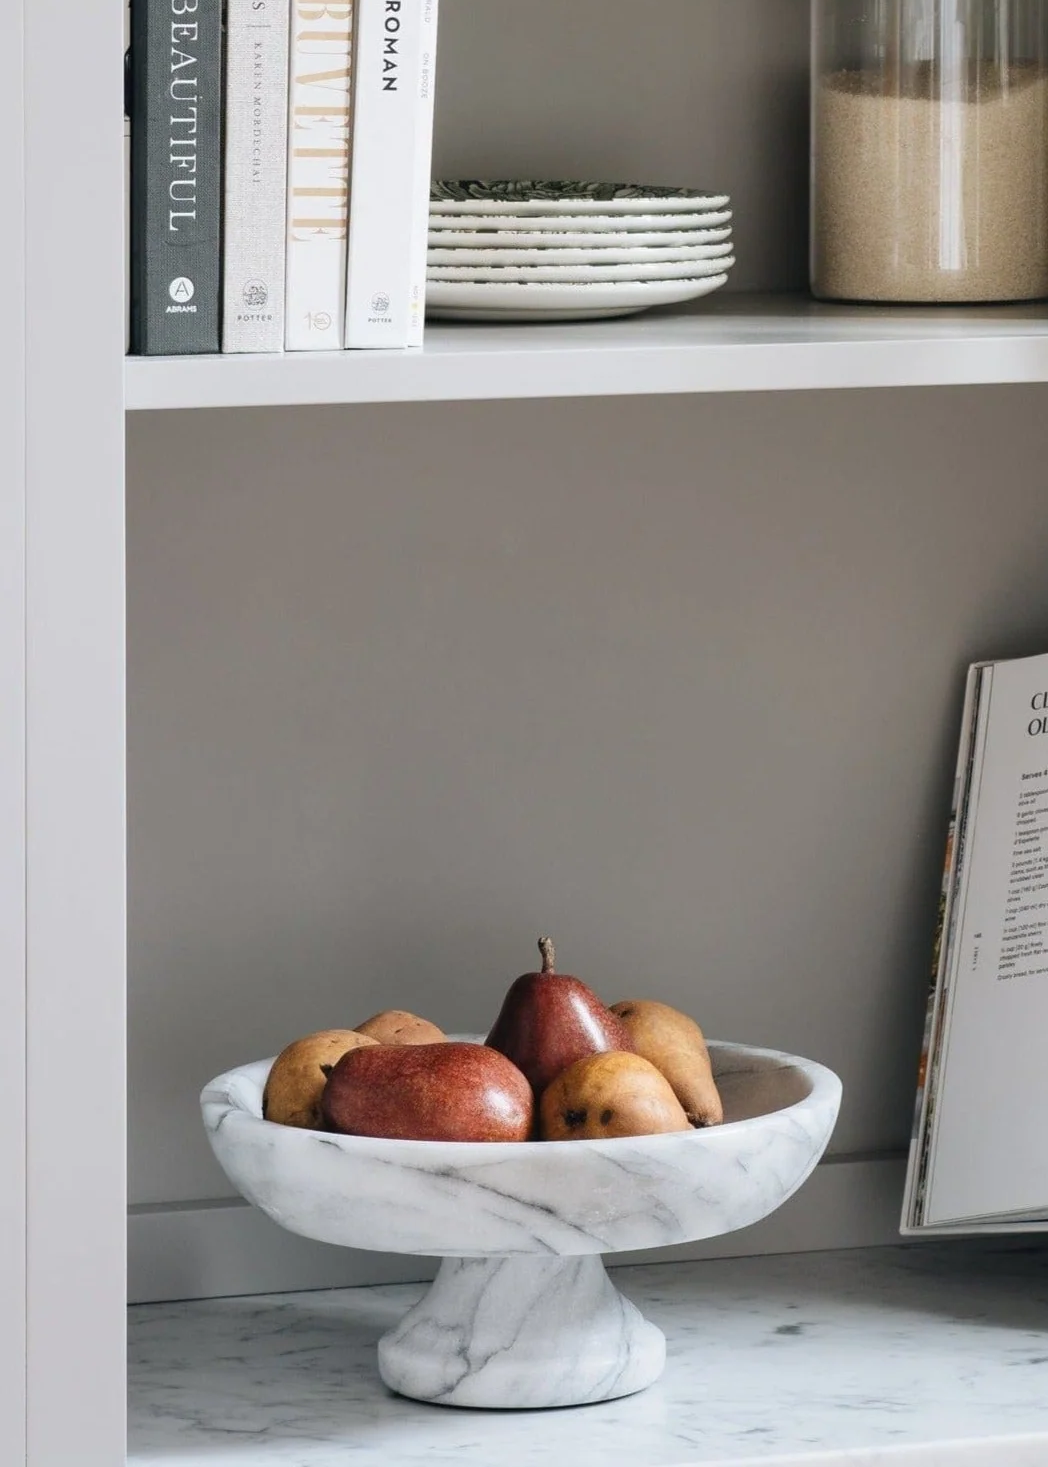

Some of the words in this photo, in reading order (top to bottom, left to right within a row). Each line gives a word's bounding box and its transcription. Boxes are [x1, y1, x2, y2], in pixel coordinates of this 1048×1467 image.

[382, 0, 400, 92] ROMAN
[253, 42, 263, 90] KAREN
[423, 52, 430, 66] ON
[420, 69, 429, 99] BOOZE
[252, 96, 262, 183] MORDECHAI
[165, 305, 197, 313] ABRAMS
[236, 314, 273, 322] POTTER
[1021, 771, 1042, 781] Serves
